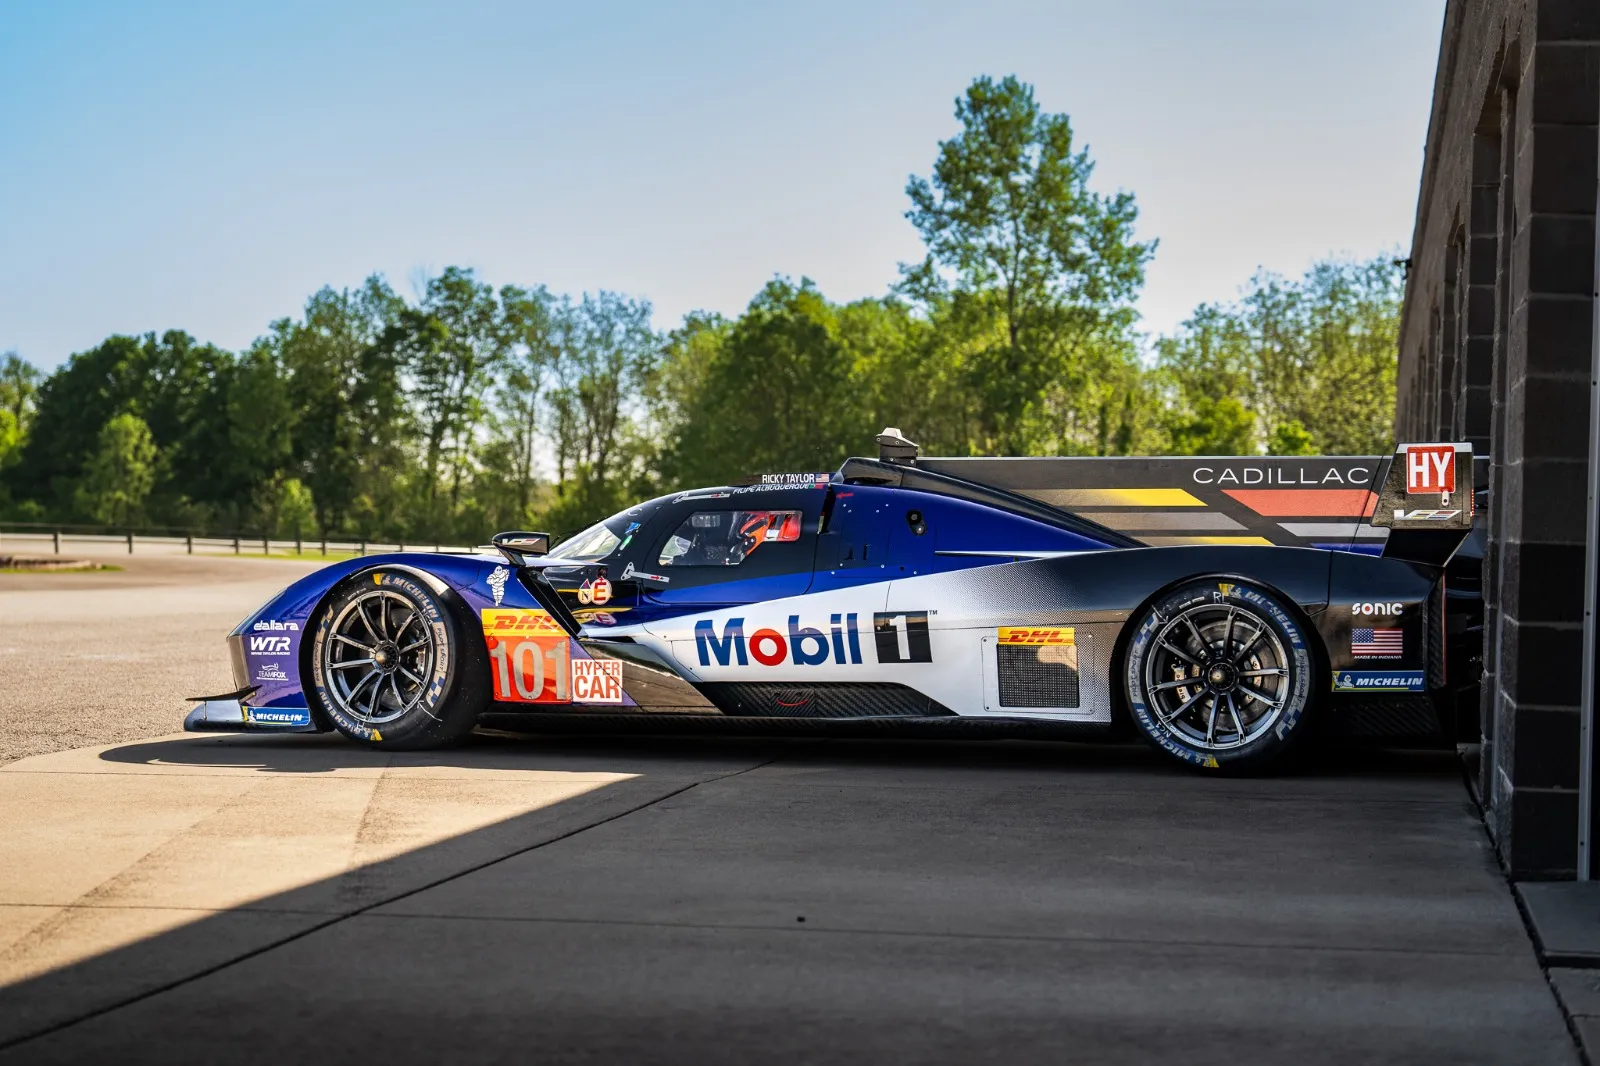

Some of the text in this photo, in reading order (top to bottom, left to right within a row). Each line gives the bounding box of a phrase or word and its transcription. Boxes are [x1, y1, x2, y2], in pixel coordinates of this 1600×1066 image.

[1193, 468, 1369, 484] CADILLAC
[1409, 452, 1452, 488] HY
[762, 473, 815, 484] RICKY TAYLOR
[392, 577, 439, 618] MICHELIN
[593, 582, 607, 601] E
[253, 620, 299, 631] dallara
[494, 615, 564, 630] DHL
[250, 636, 291, 651] WTR
[694, 612, 863, 666] Mobil
[1007, 630, 1064, 643] DHL
[489, 640, 567, 700] 101
[574, 661, 621, 676] HYPER
[574, 676, 621, 699] CAR
[1355, 677, 1424, 686] MICHELIN
[256, 713, 303, 722] MICHELIN
[1136, 708, 1192, 760] MICHELIN
